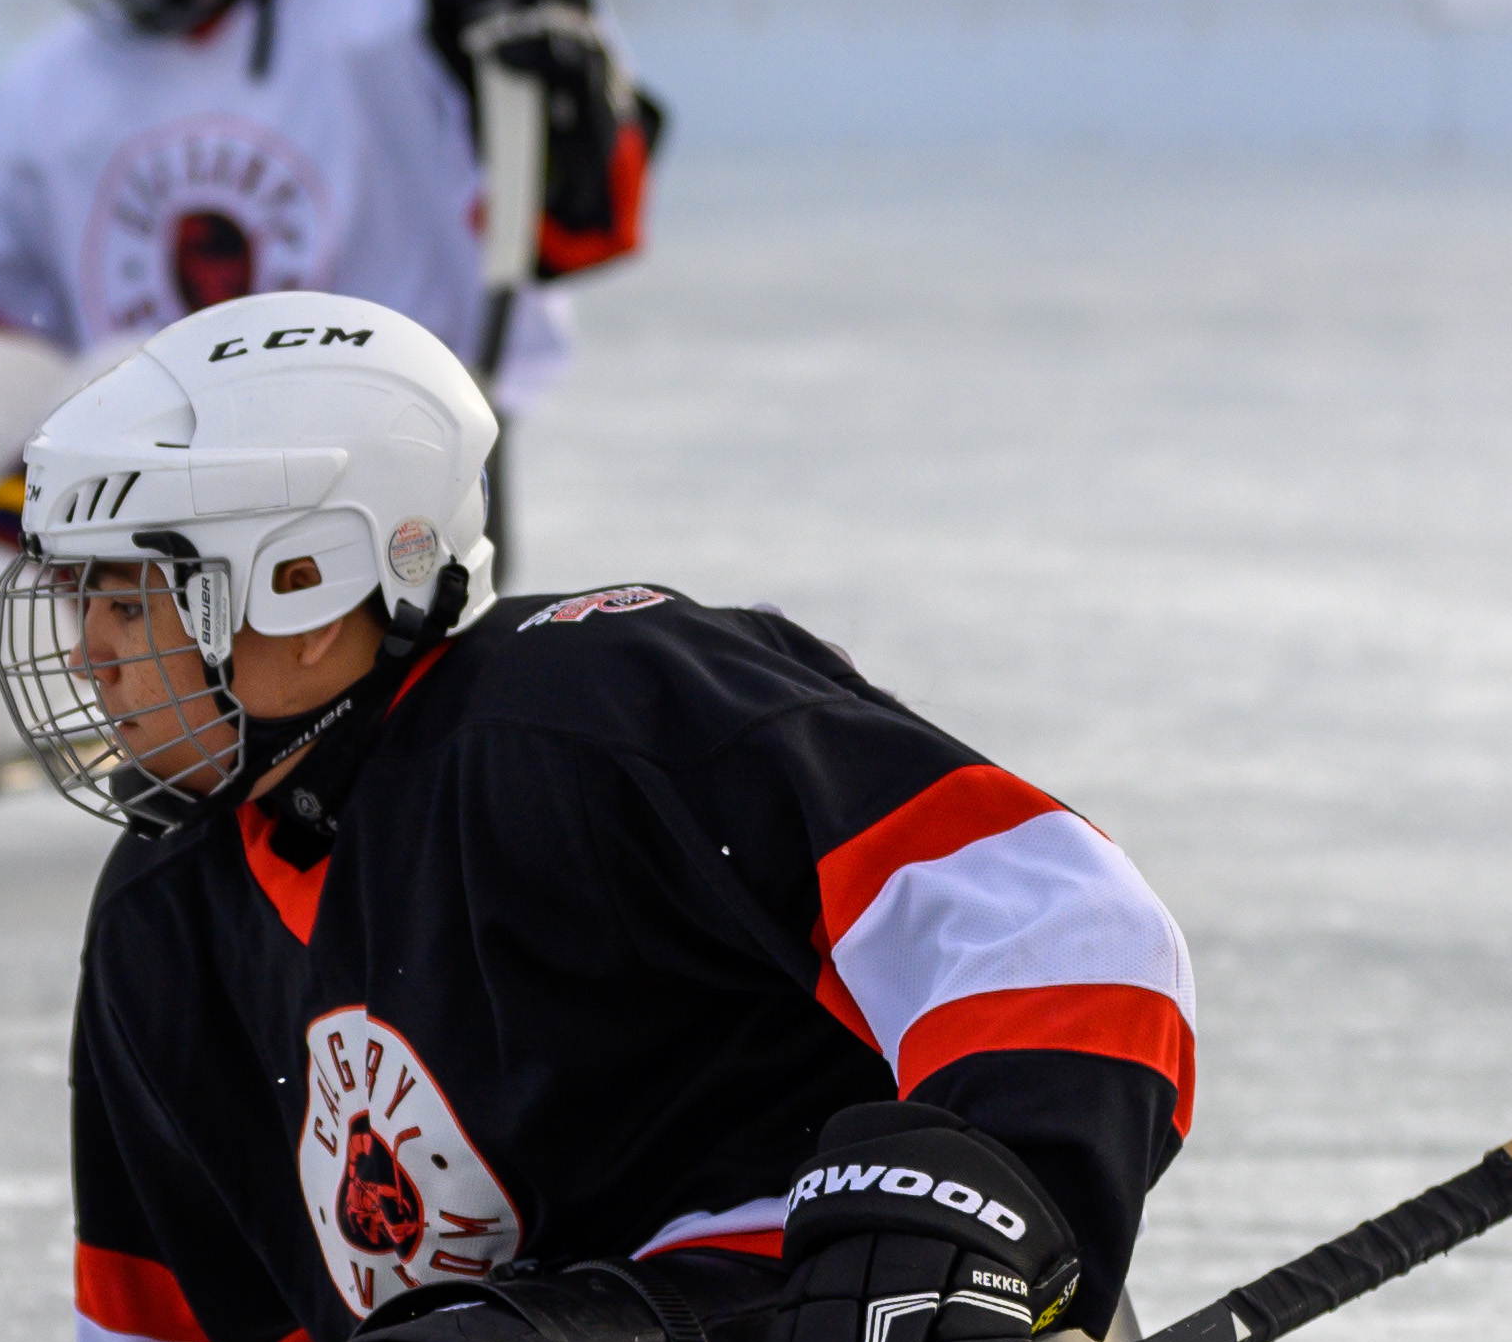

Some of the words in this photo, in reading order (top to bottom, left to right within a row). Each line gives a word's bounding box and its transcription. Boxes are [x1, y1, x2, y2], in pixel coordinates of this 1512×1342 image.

[208, 327, 374, 363] CCM
[201, 576, 212, 646] BAUER
[972, 1270, 1028, 1297] REKKER
